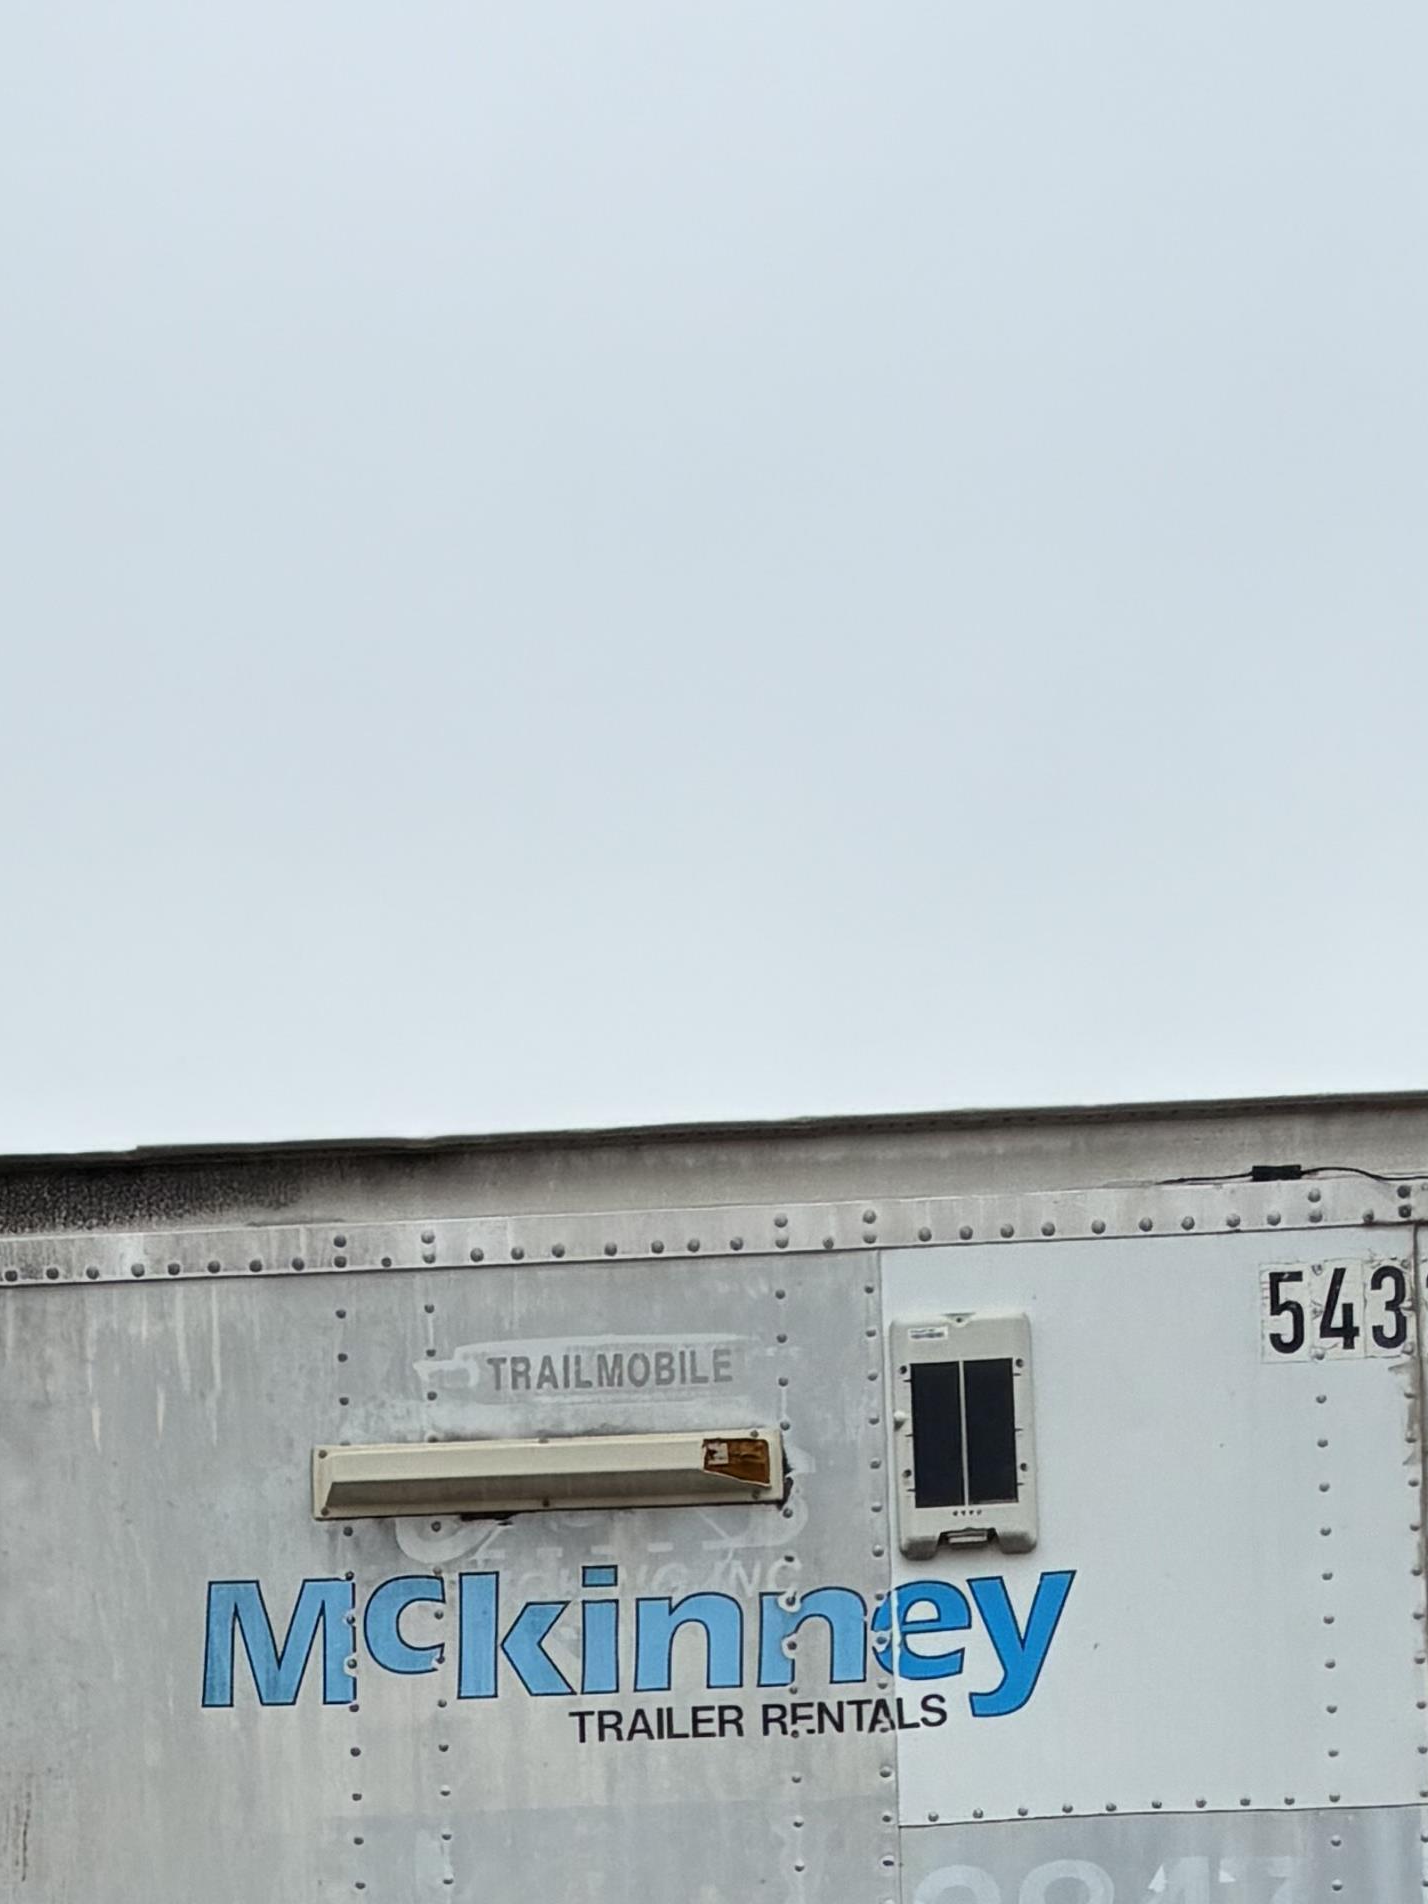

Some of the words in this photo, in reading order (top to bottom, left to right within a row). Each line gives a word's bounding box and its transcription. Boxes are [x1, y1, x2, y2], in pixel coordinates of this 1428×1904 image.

[486, 1348, 734, 1391] TRAILMOBILE
[570, 1703, 744, 1745] TRAILER
[762, 1694, 948, 1738] RENTALS
